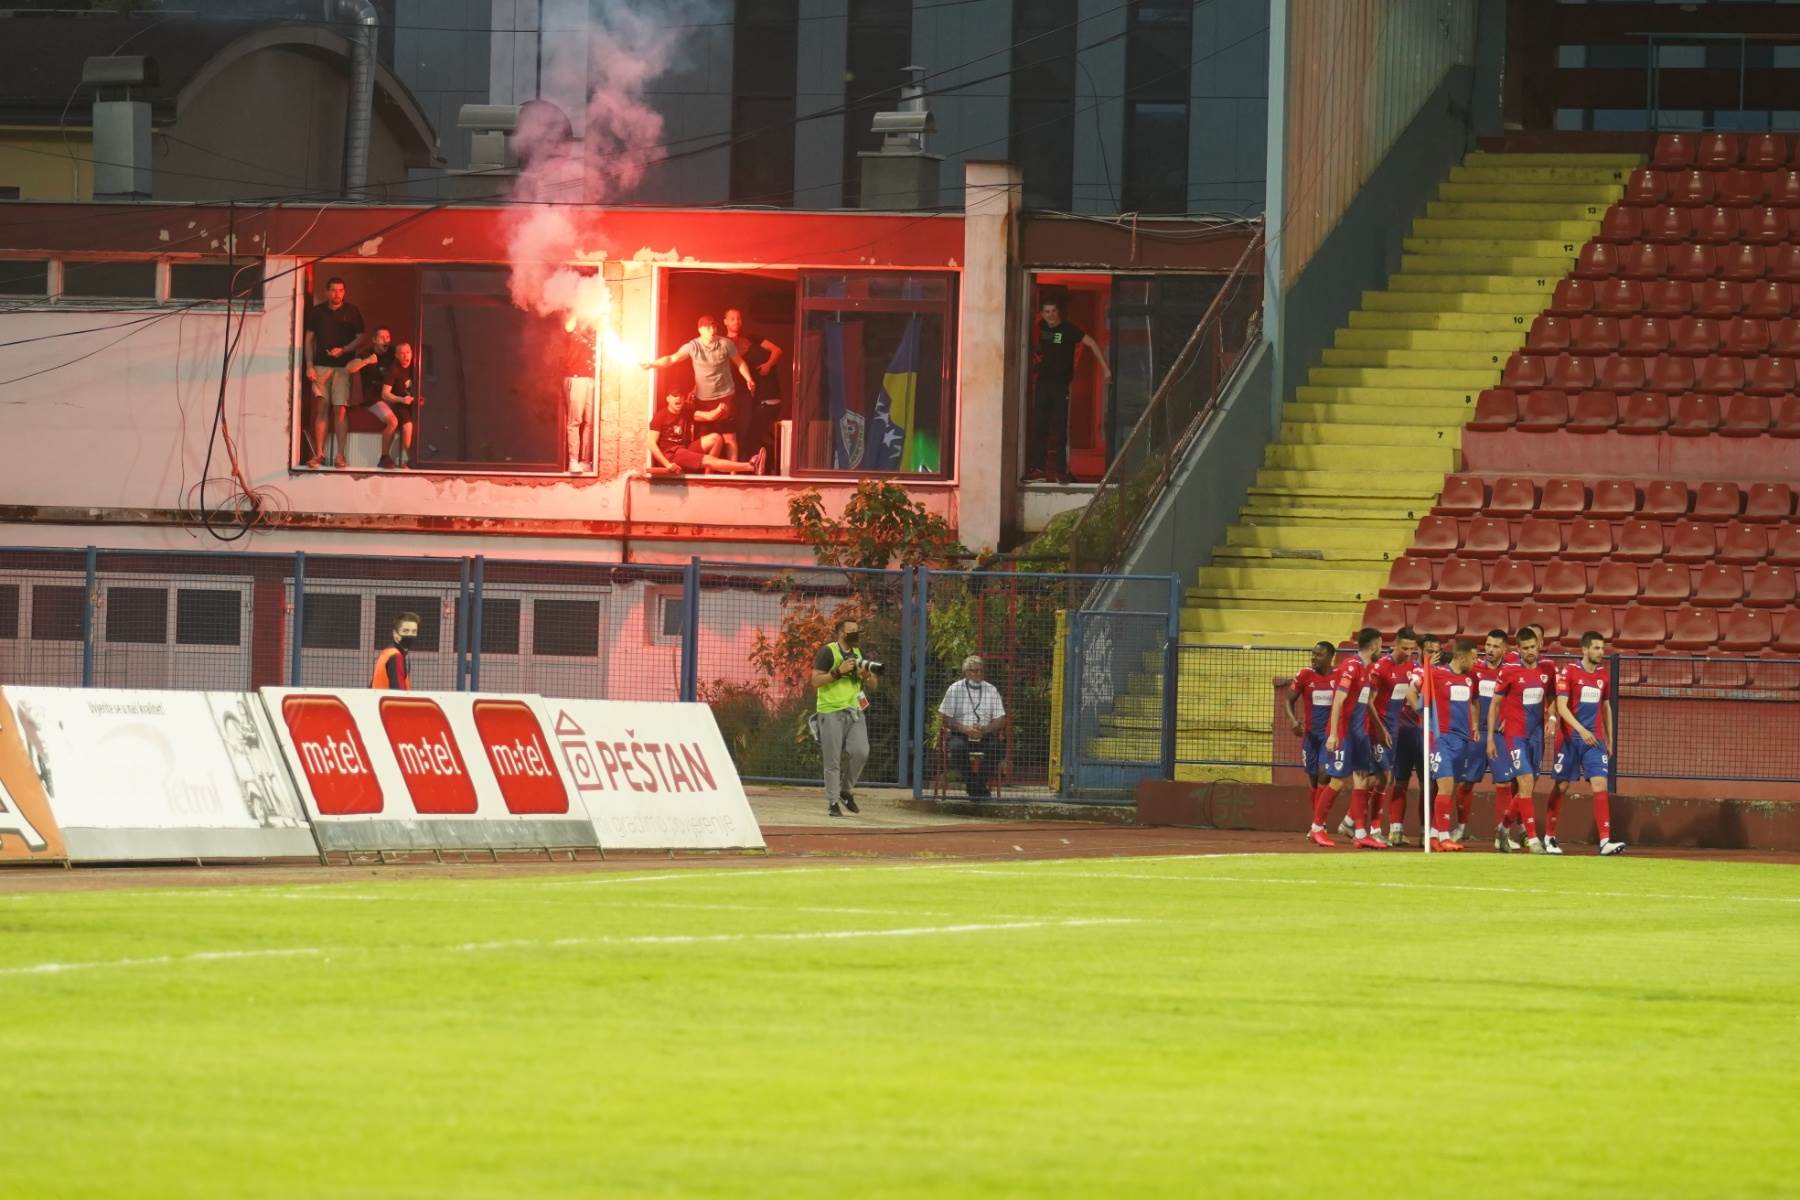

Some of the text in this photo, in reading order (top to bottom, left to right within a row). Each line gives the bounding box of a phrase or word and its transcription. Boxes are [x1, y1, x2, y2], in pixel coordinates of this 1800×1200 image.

[1514, 316, 1524, 324] 10
[301, 729, 368, 774] m:tel
[396, 731, 461, 775] m:tel
[490, 733, 551, 776] m:tel
[595, 729, 718, 793] PEŠTAN
[1334, 750, 1344, 761] 11
[1510, 749, 1521, 760] 17
